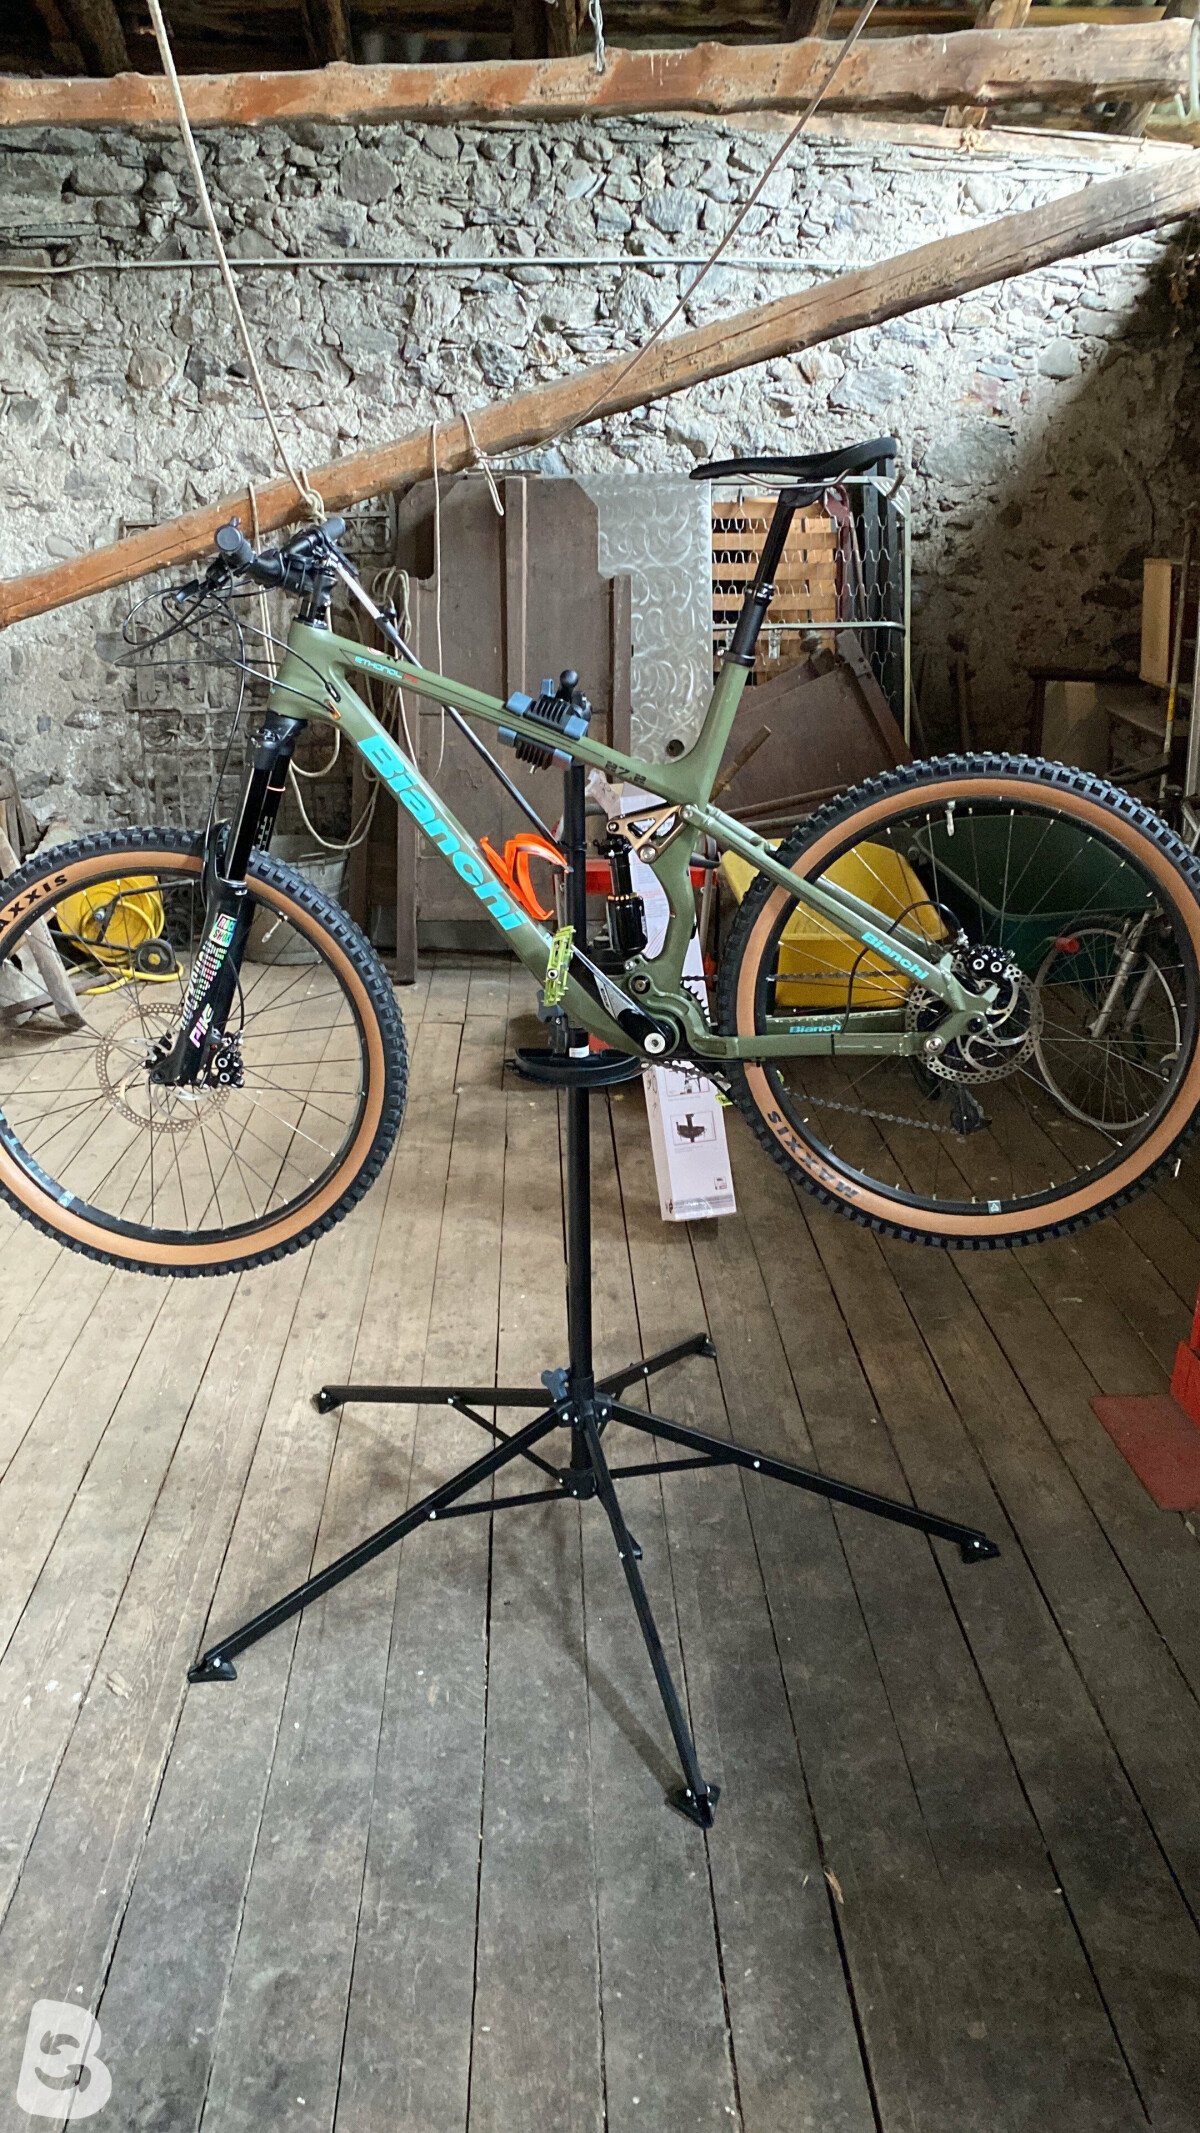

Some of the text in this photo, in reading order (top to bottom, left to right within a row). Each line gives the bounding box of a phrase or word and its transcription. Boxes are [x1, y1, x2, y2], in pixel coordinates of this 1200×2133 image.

[357, 734, 528, 931] Bianchi
[0, 875, 67, 933] AXXIS
[861, 931, 929, 980] Bianchi
[189, 1003, 214, 1049] PIKE
[789, 1024, 843, 1033] Bianch
[767, 1111, 859, 1198] MAXXIS
